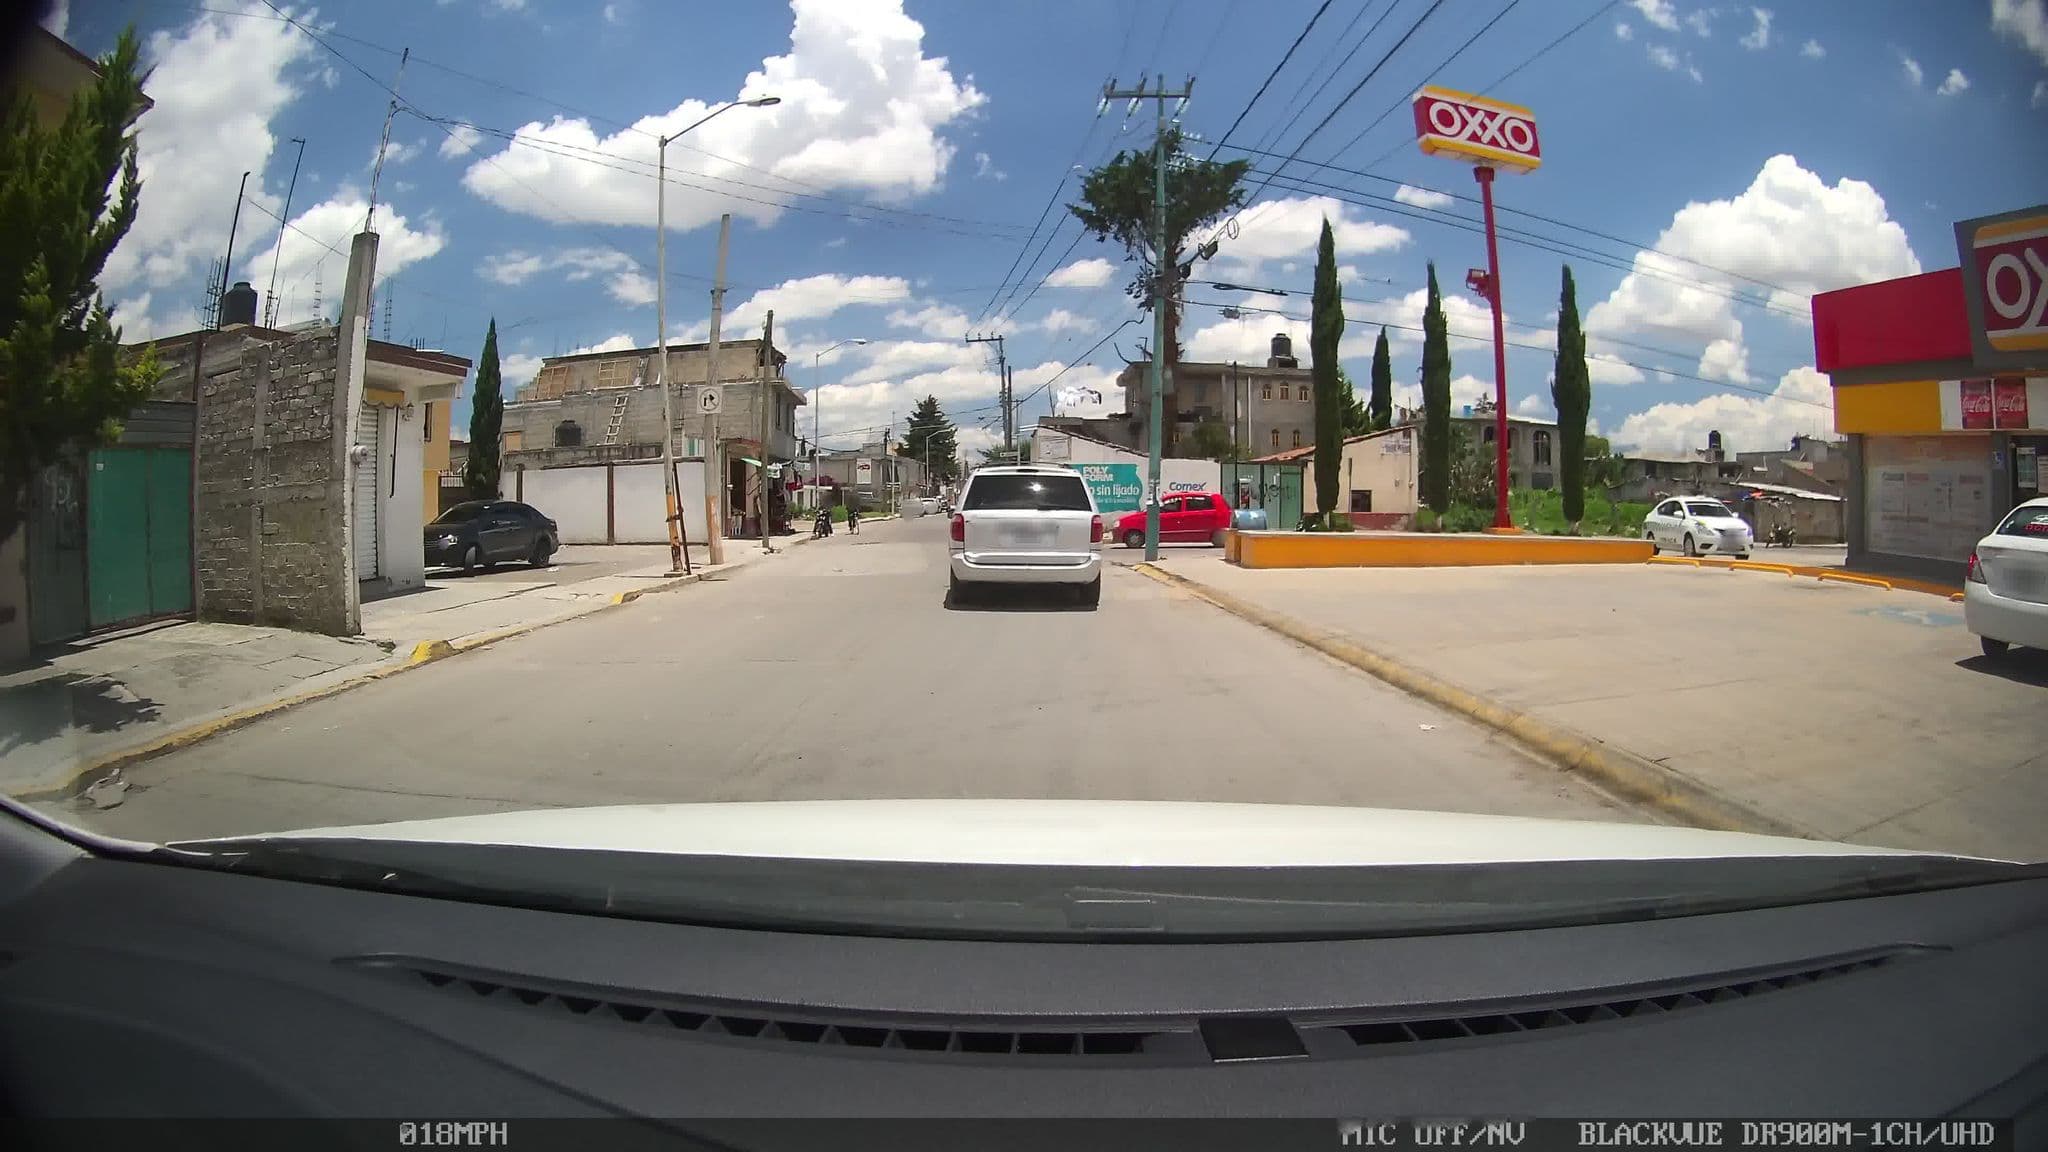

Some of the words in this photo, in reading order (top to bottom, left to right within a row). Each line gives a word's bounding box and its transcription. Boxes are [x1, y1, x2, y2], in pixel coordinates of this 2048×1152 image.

[1429, 101, 1533, 152] OXXO
[1083, 466, 1109, 475] POLY
[1096, 485, 1111, 496] sin
[1113, 484, 1140, 498] lijado
[1169, 482, 1207, 491] Comex
